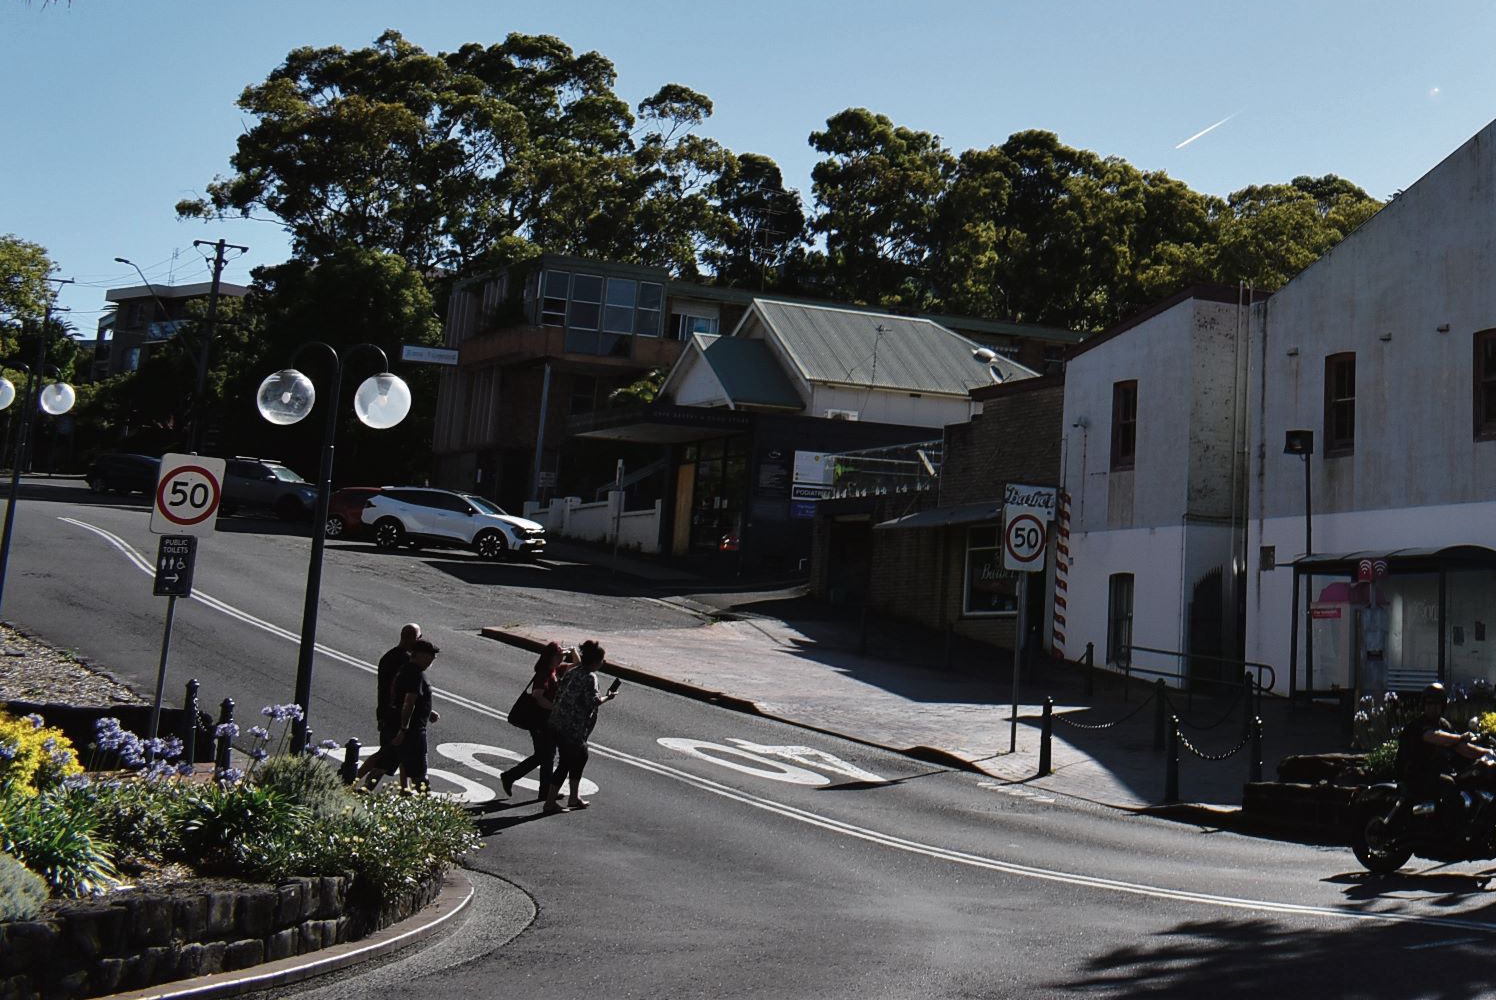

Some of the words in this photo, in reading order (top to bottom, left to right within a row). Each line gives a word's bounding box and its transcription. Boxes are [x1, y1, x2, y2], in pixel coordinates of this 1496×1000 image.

[168, 480, 209, 509] 50
[795, 489, 832, 498] PODIATR
[1014, 527, 1039, 549] 50
[163, 546, 189, 554] TOILETS
